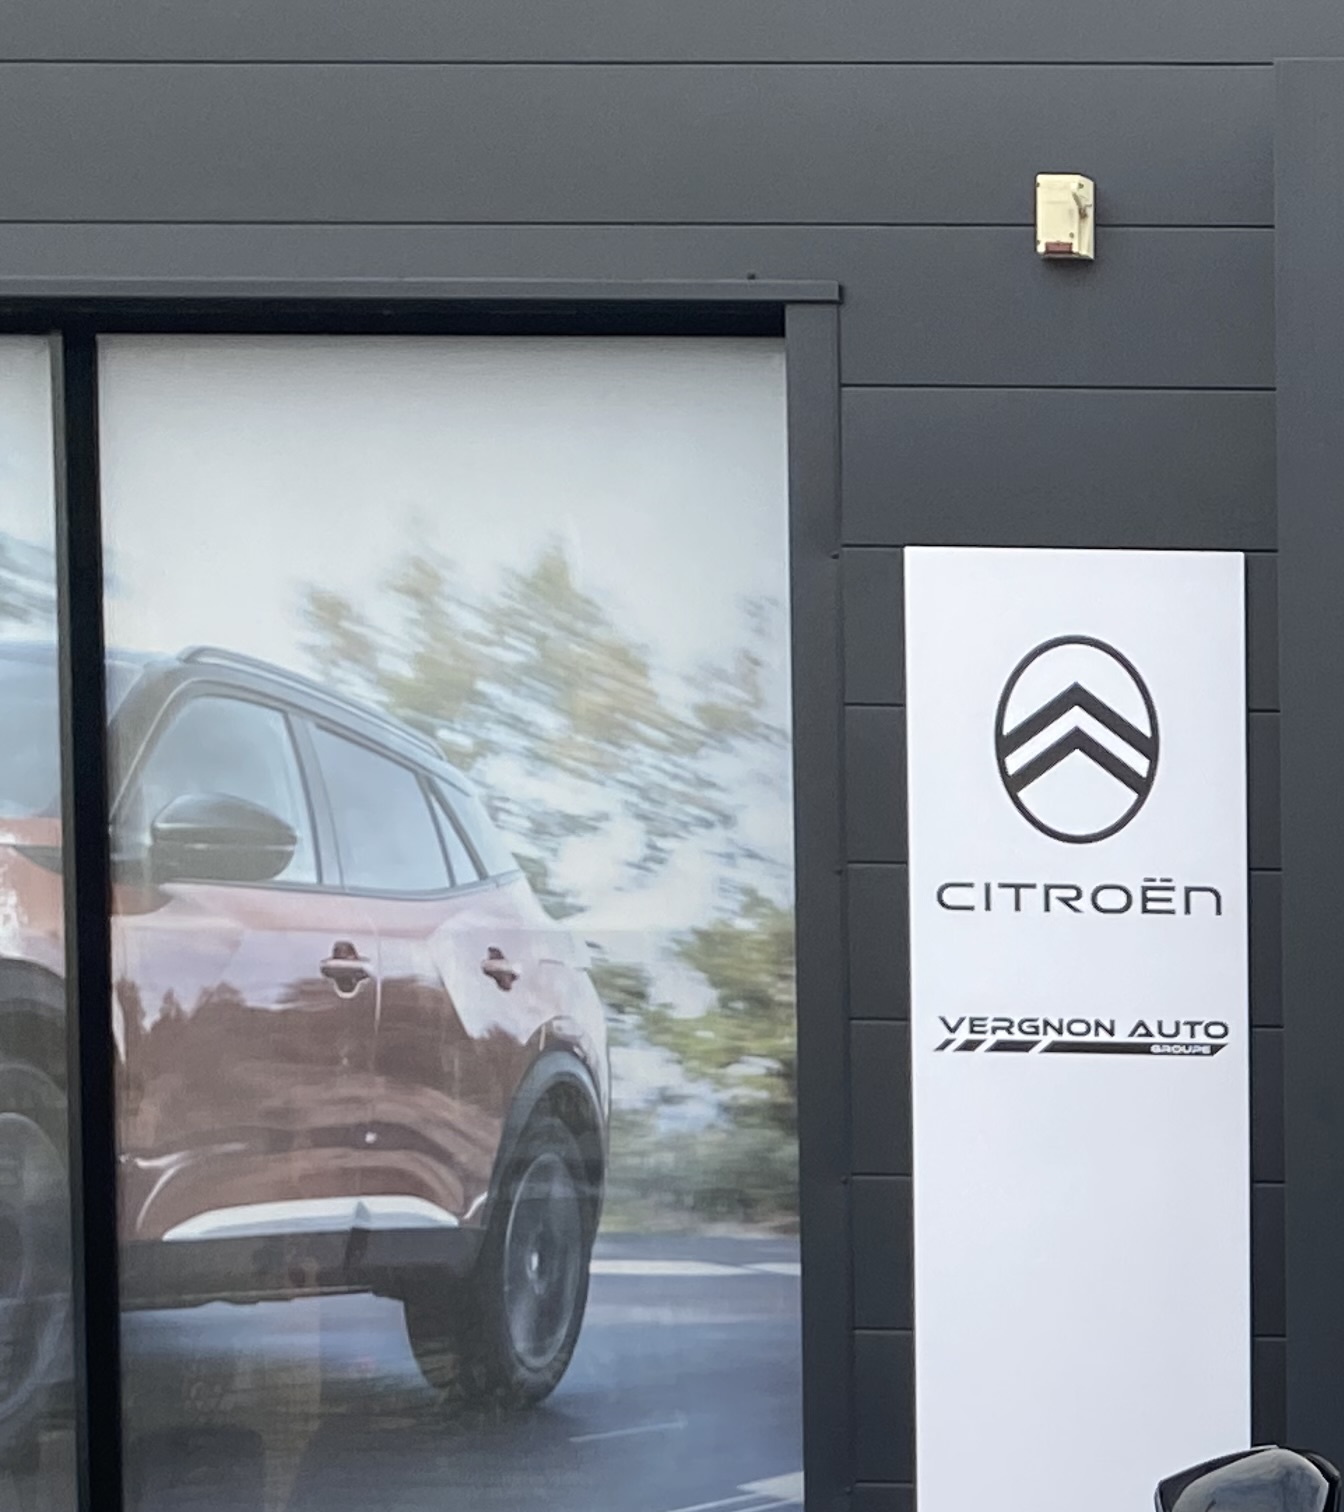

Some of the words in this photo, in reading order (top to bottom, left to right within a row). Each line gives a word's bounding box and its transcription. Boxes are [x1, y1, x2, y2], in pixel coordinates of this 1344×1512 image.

[936, 877, 1223, 916] CITROËN
[938, 1016, 1116, 1037] VERGNON
[1128, 1019, 1230, 1040] AUTO
[1150, 1045, 1211, 1054] GROUPE
